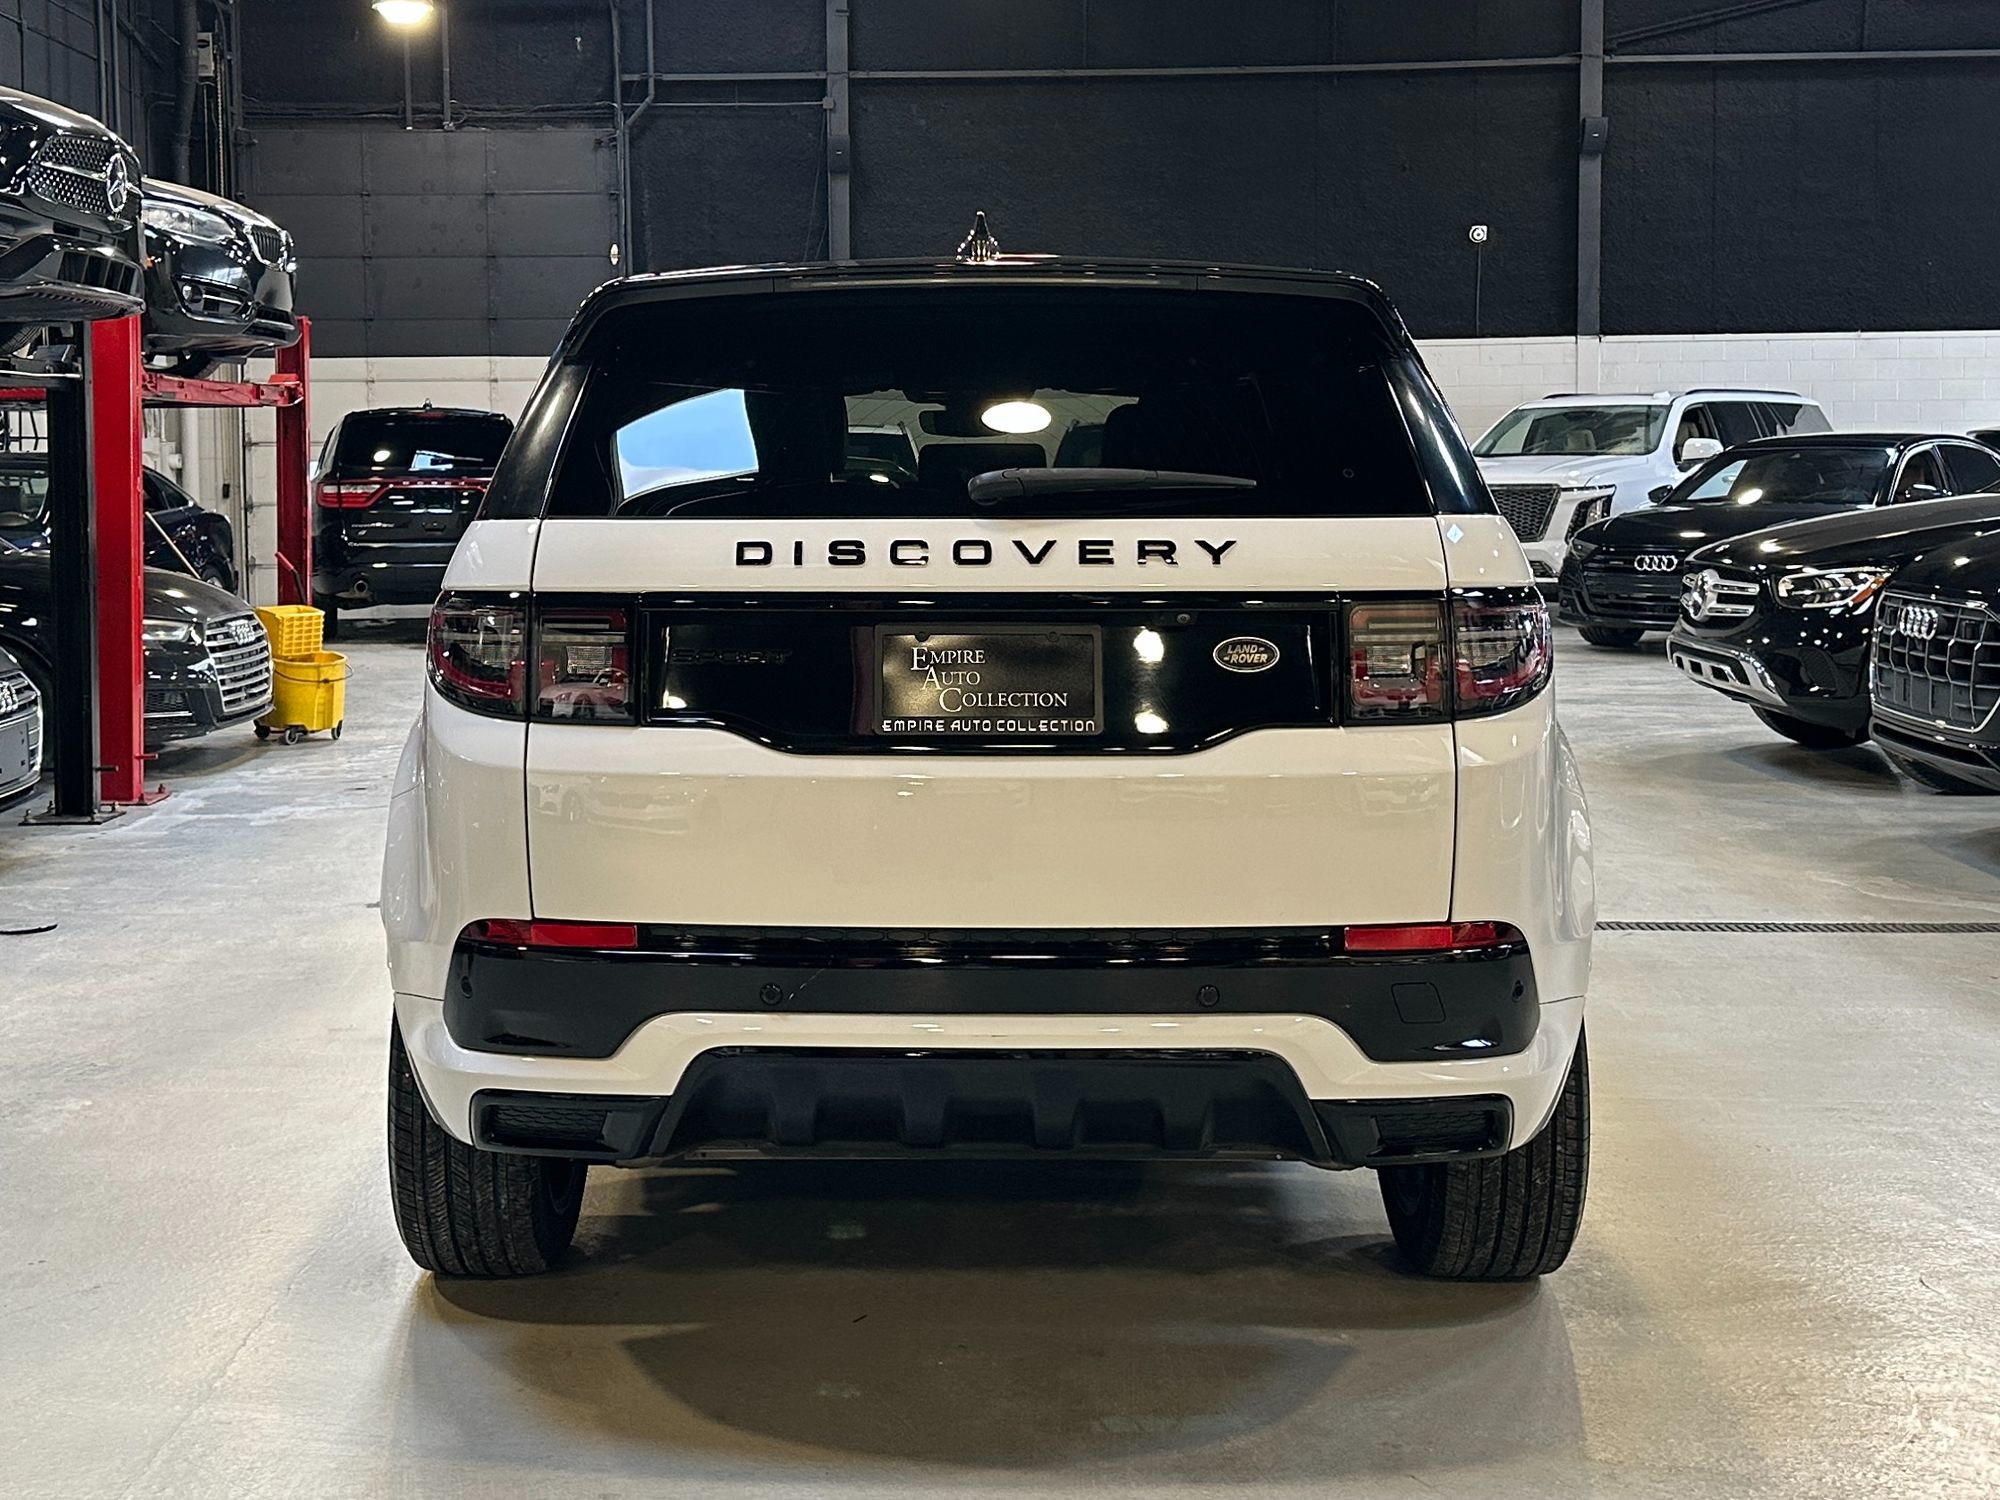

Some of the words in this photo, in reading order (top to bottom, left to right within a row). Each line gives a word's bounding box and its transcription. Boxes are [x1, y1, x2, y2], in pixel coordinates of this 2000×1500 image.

[735, 539, 1238, 566] DISCOVERY
[911, 646, 986, 671] EMPIRE
[922, 666, 981, 690] AUTO
[939, 687, 1068, 712] COLLECTION
[882, 719, 945, 732] EMPIRE
[951, 719, 992, 732] AUTO
[996, 719, 1096, 732] COLLECTION
